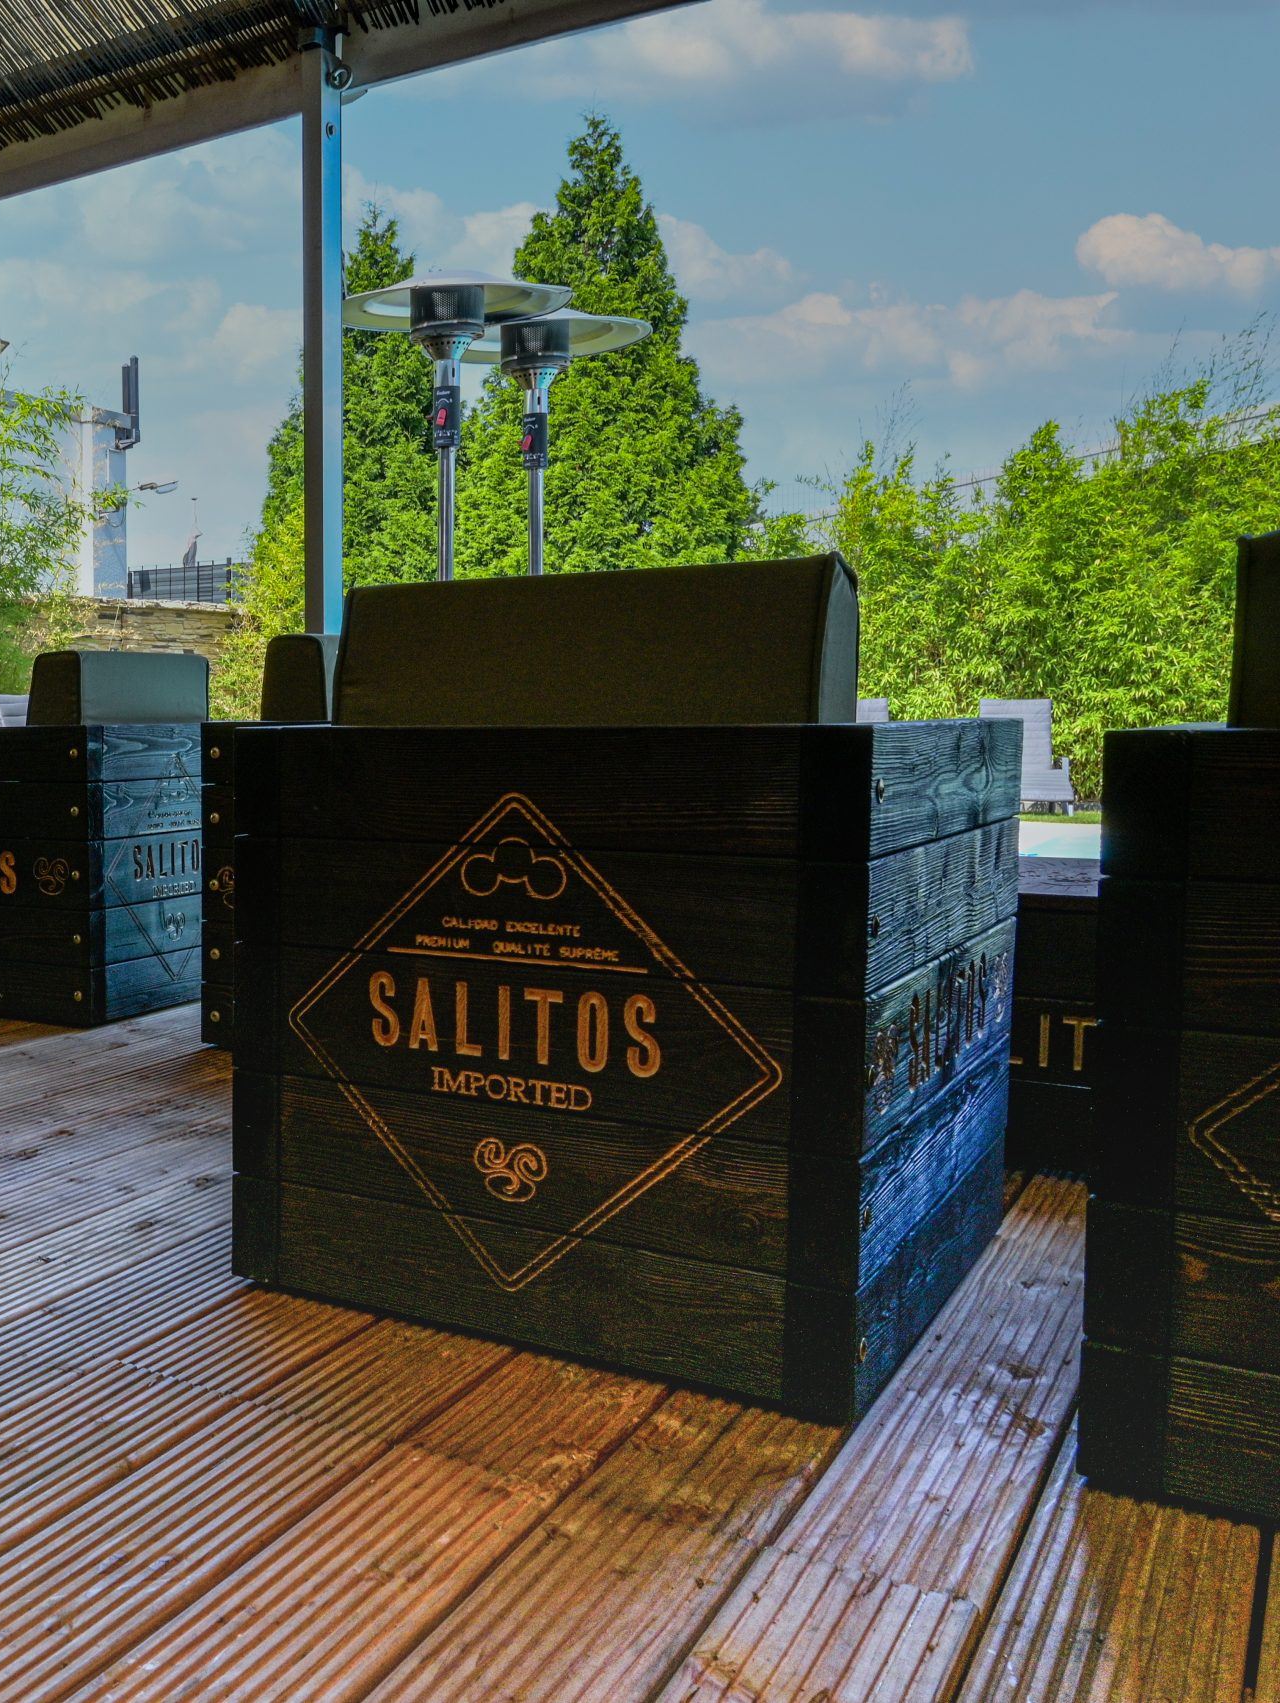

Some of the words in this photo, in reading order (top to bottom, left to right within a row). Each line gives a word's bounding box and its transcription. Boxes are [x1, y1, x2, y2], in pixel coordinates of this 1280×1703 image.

[415, 934, 470, 949] PREMIUM
[505, 920, 581, 938] EXCELENTE
[368, 970, 662, 1079] SALITOS
[430, 1066, 593, 1112] IMPORTED
